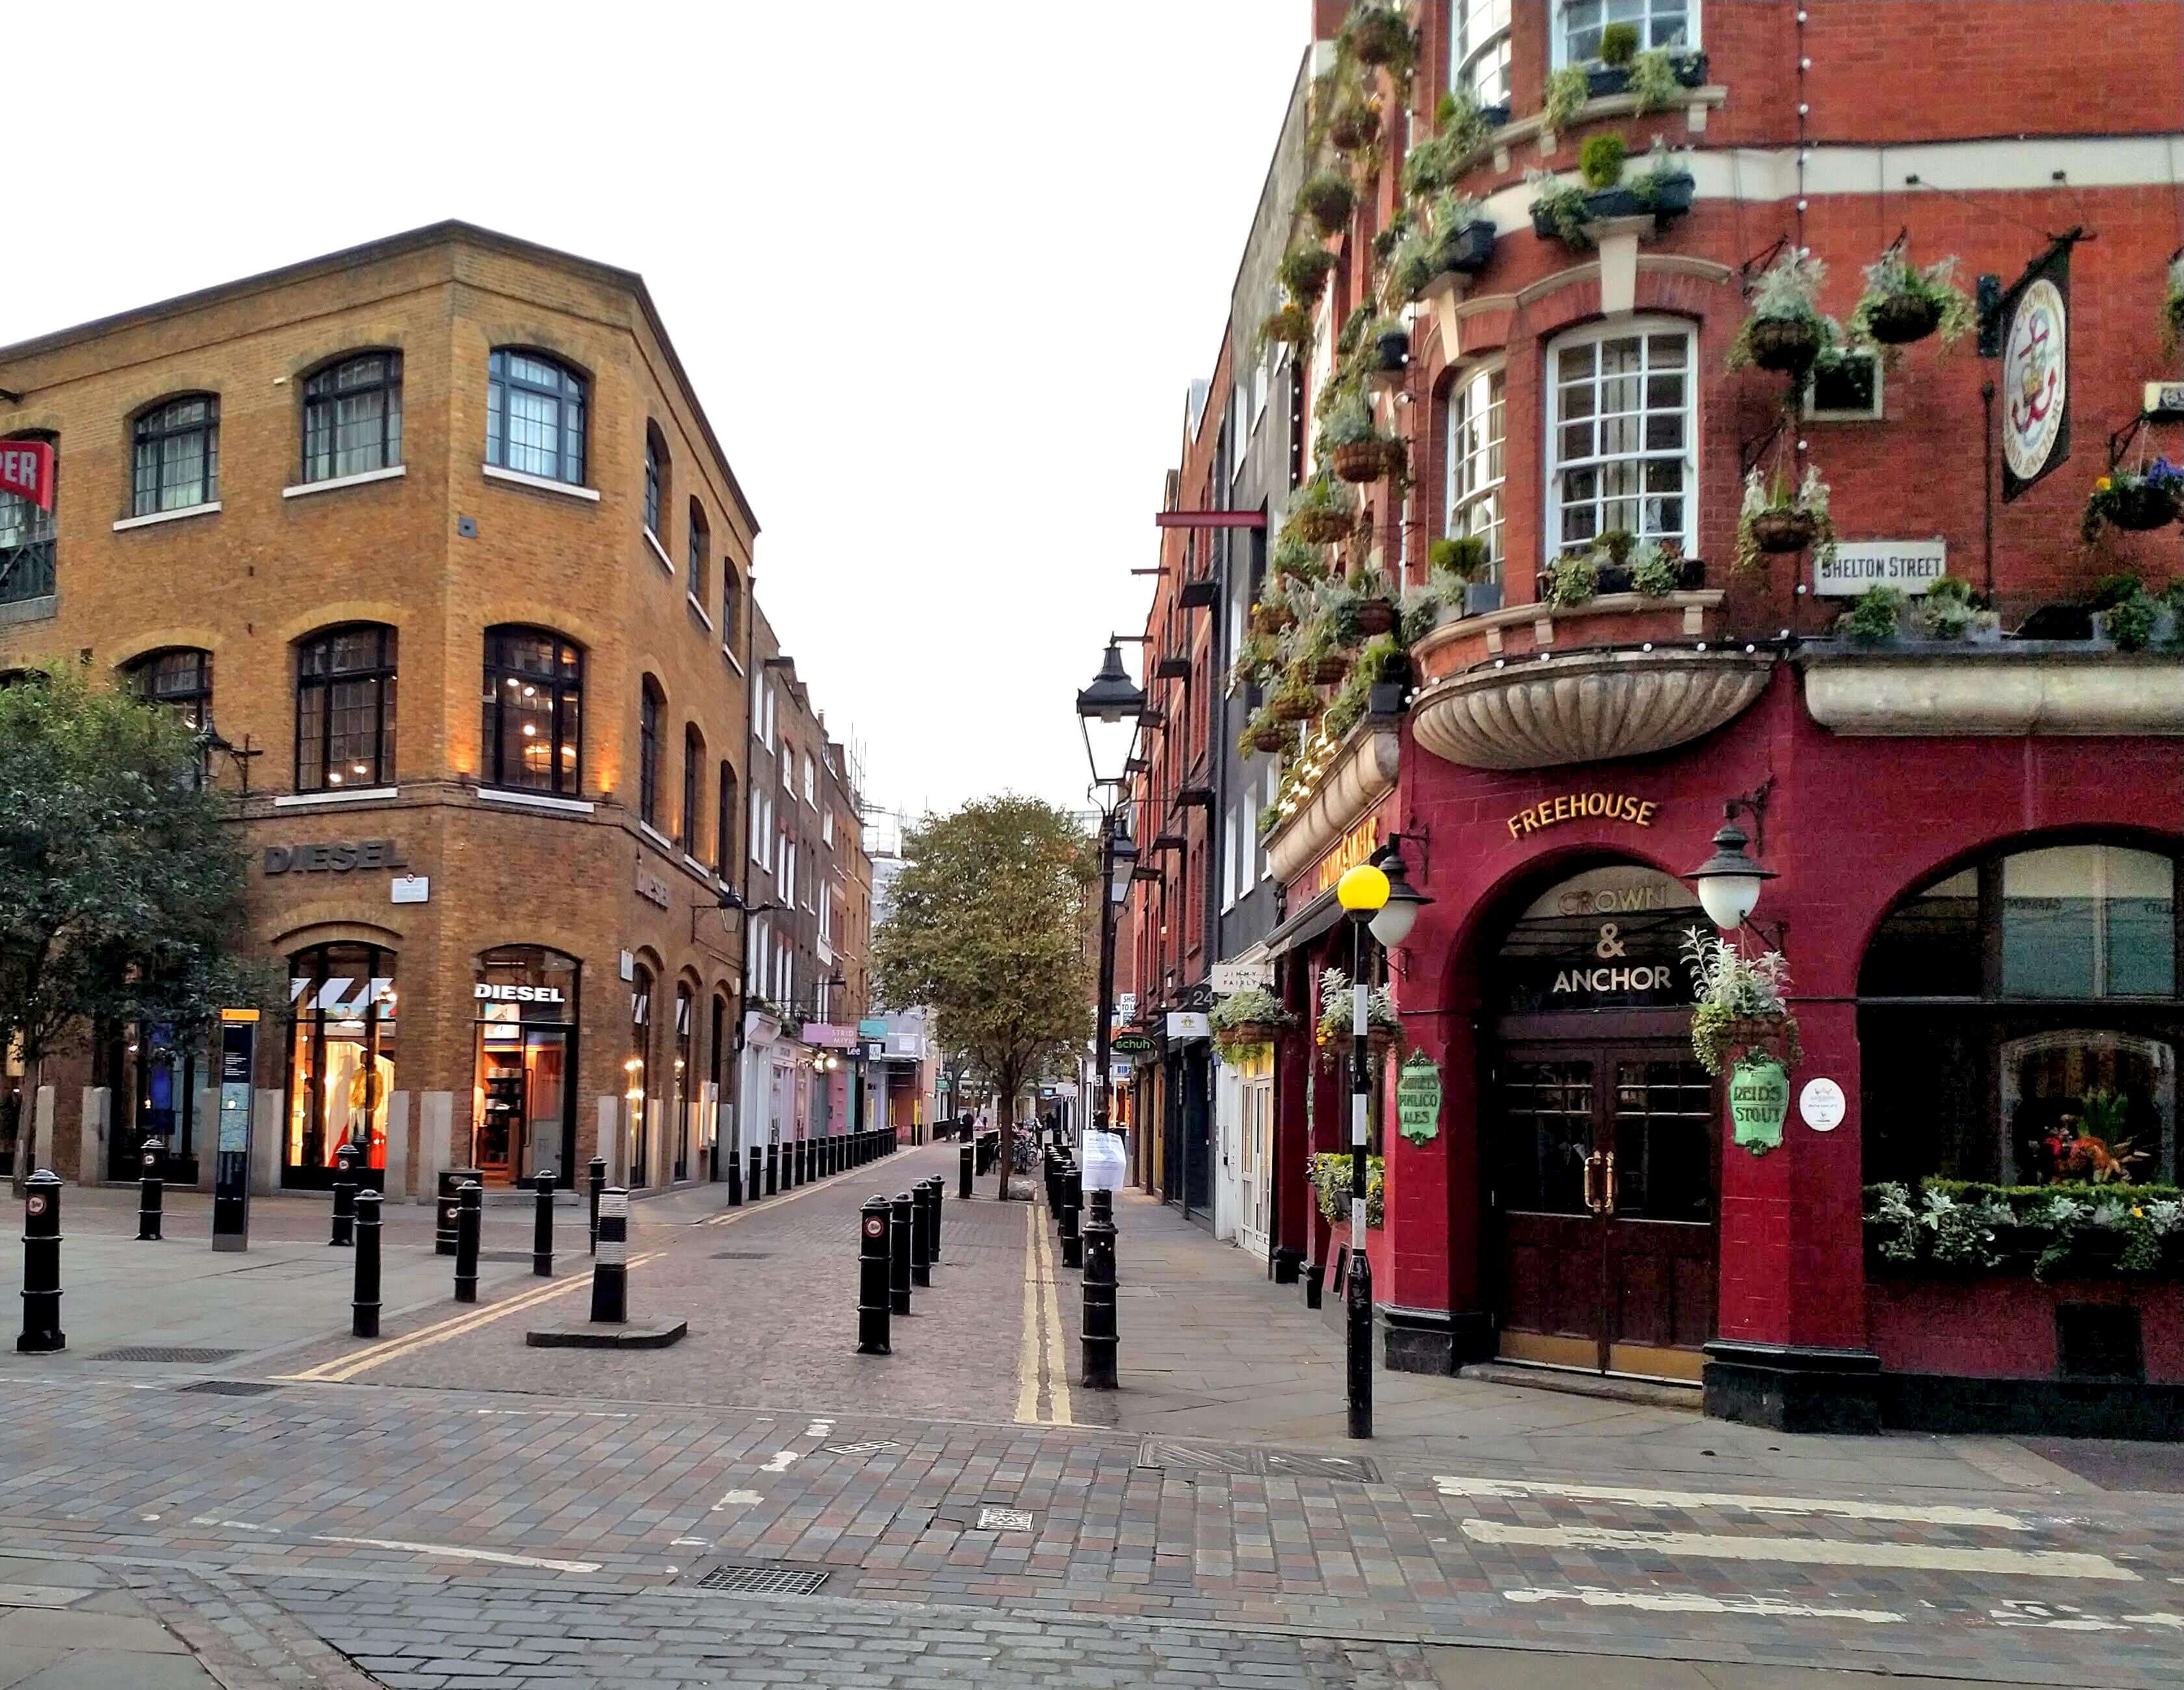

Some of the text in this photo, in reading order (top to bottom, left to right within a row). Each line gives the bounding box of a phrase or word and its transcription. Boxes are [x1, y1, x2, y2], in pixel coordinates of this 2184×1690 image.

[0, 451, 36, 489] ER
[1822, 556, 1942, 578] SHELTON STREET
[1507, 792, 1658, 839] FREEHOUSE
[265, 838, 408, 874] DIESEL
[1559, 883, 1669, 913] CROWN
[1596, 922, 1626, 958] &
[1553, 966, 1672, 993] ANCHOR
[474, 983, 566, 1002] DIESEL
[847, 1046, 861, 1055] Lee
[1115, 1040, 1150, 1049] schuh
[1734, 1082, 1782, 1101] REID'S
[1736, 1107, 1780, 1123] STOUT
